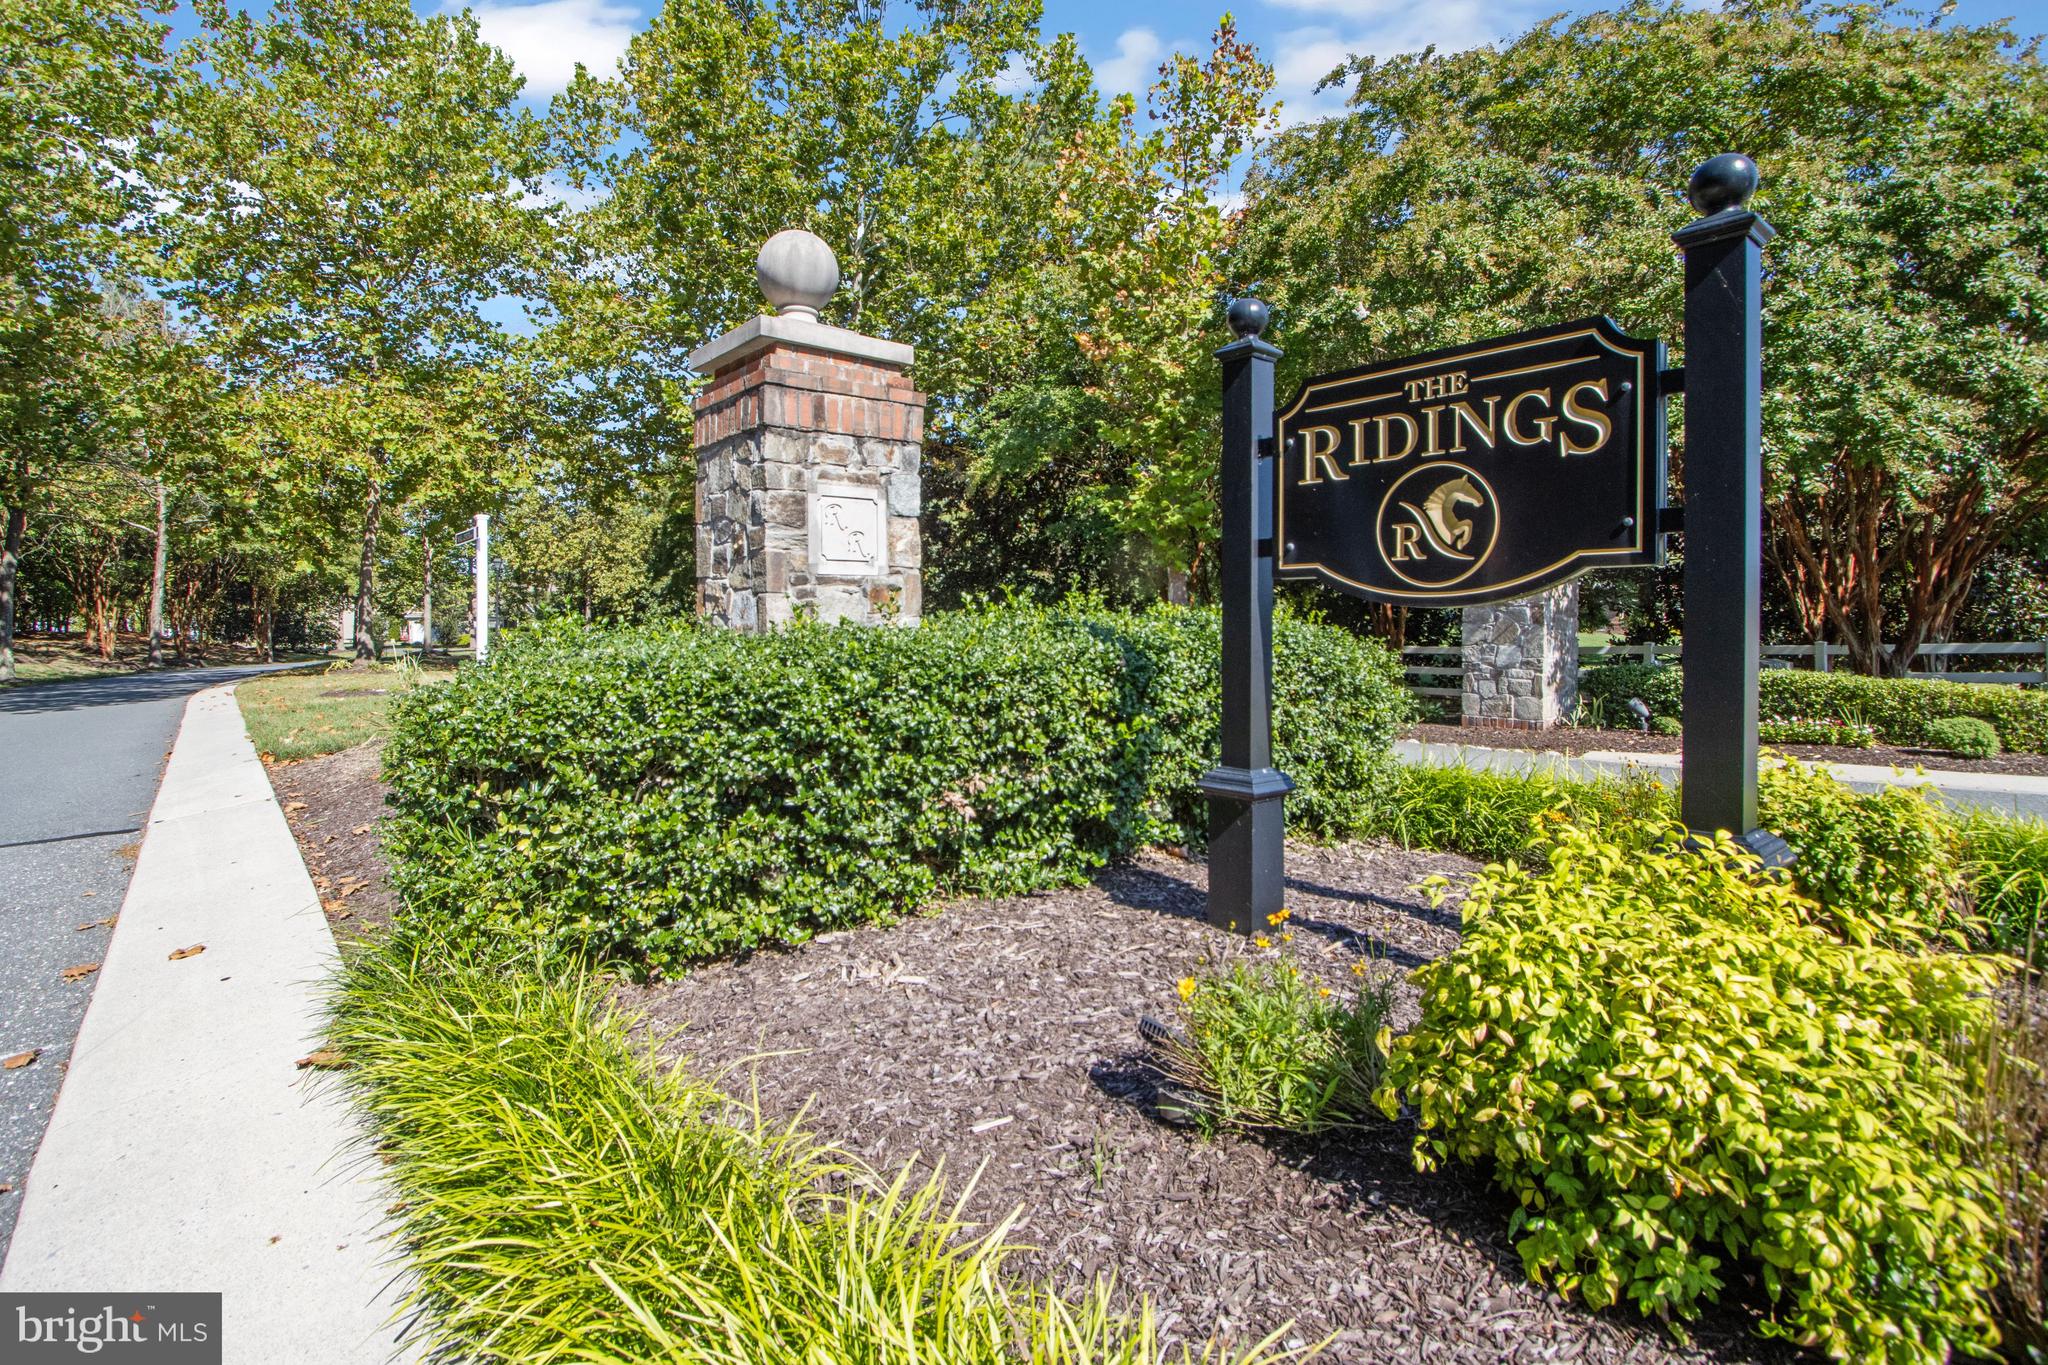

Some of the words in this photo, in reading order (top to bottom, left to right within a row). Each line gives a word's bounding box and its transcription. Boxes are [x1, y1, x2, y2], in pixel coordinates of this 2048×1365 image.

[1405, 371, 1469, 402] THE
[1298, 378, 1612, 485] RIDINGS
[1391, 523, 1427, 561] R
